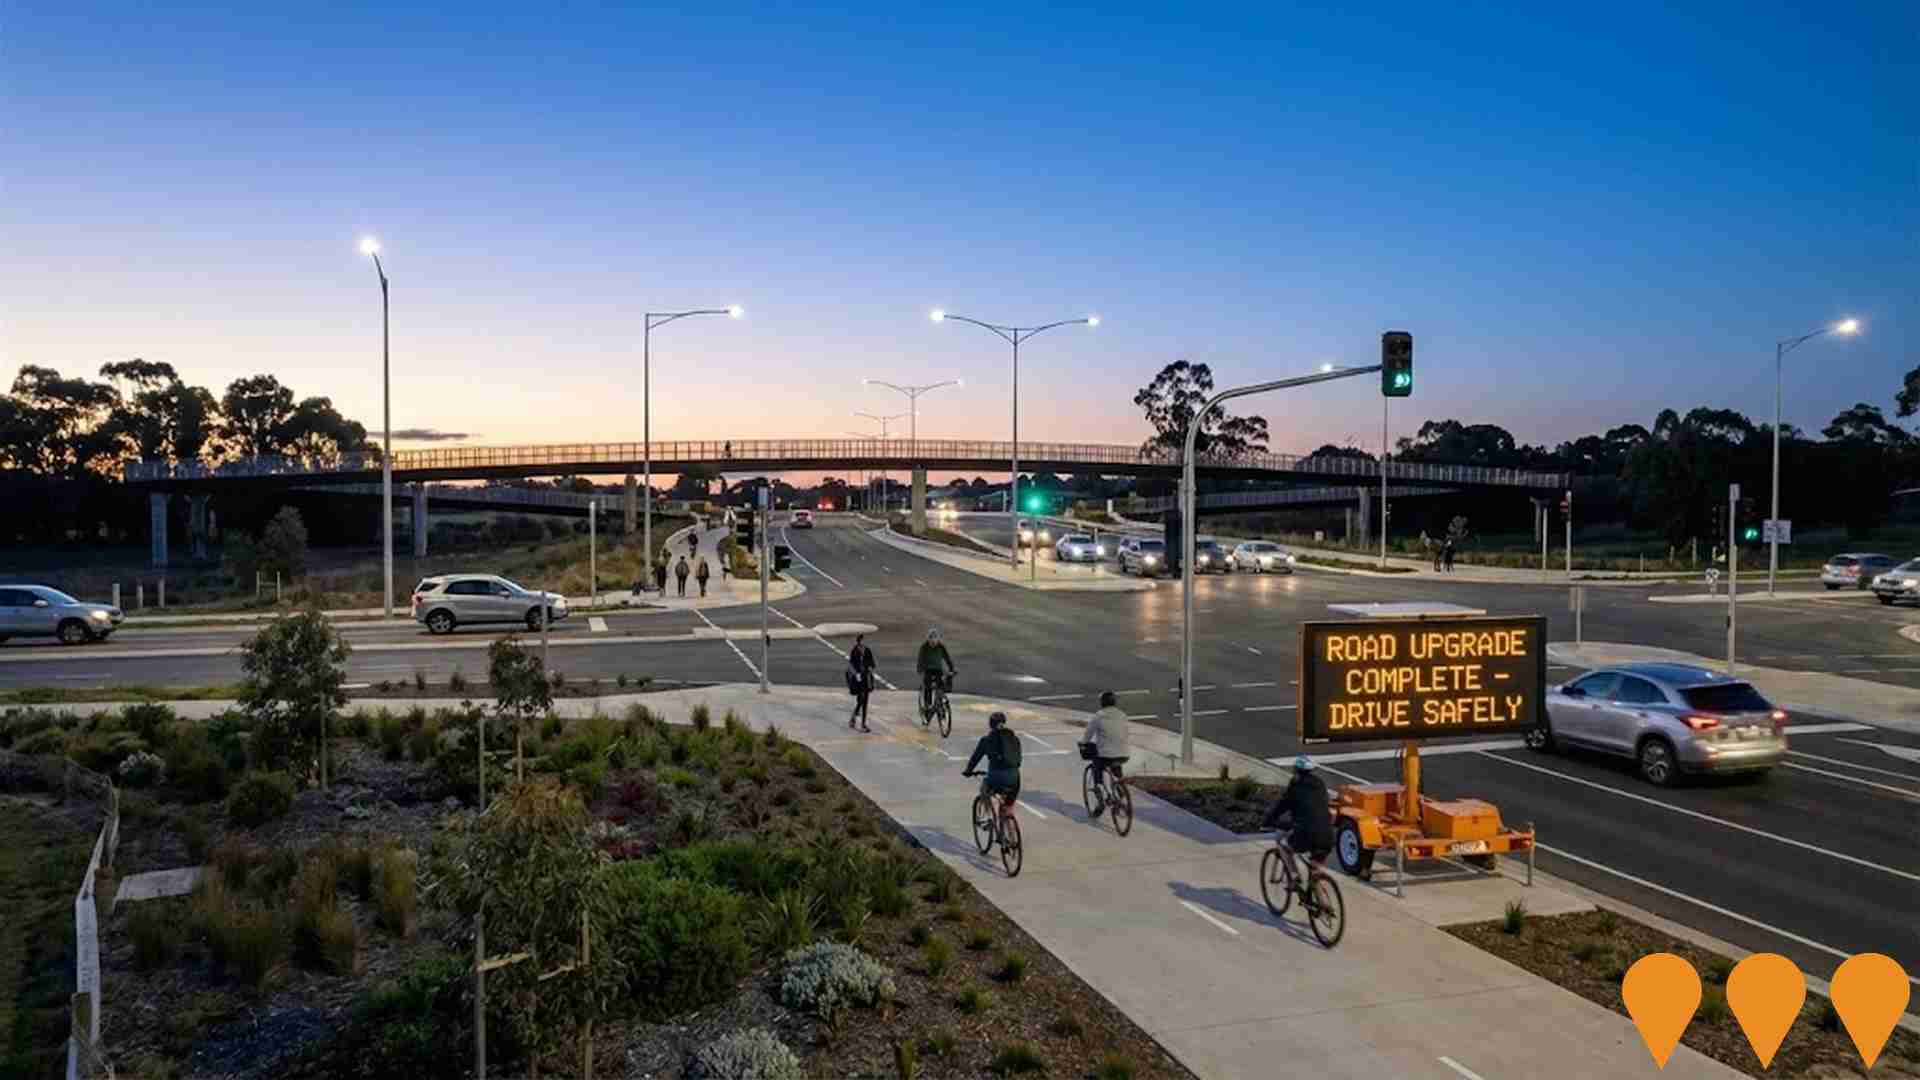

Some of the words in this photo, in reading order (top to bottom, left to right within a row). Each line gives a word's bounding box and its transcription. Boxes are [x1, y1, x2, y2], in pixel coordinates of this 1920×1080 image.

[1327, 634, 1396, 661] ROAD
[1410, 630, 1526, 659] UPGRADE
[1346, 665, 1482, 694] COMPLETE
[1329, 700, 1410, 729] DRIVE
[1423, 696, 1522, 724] SAFELY
